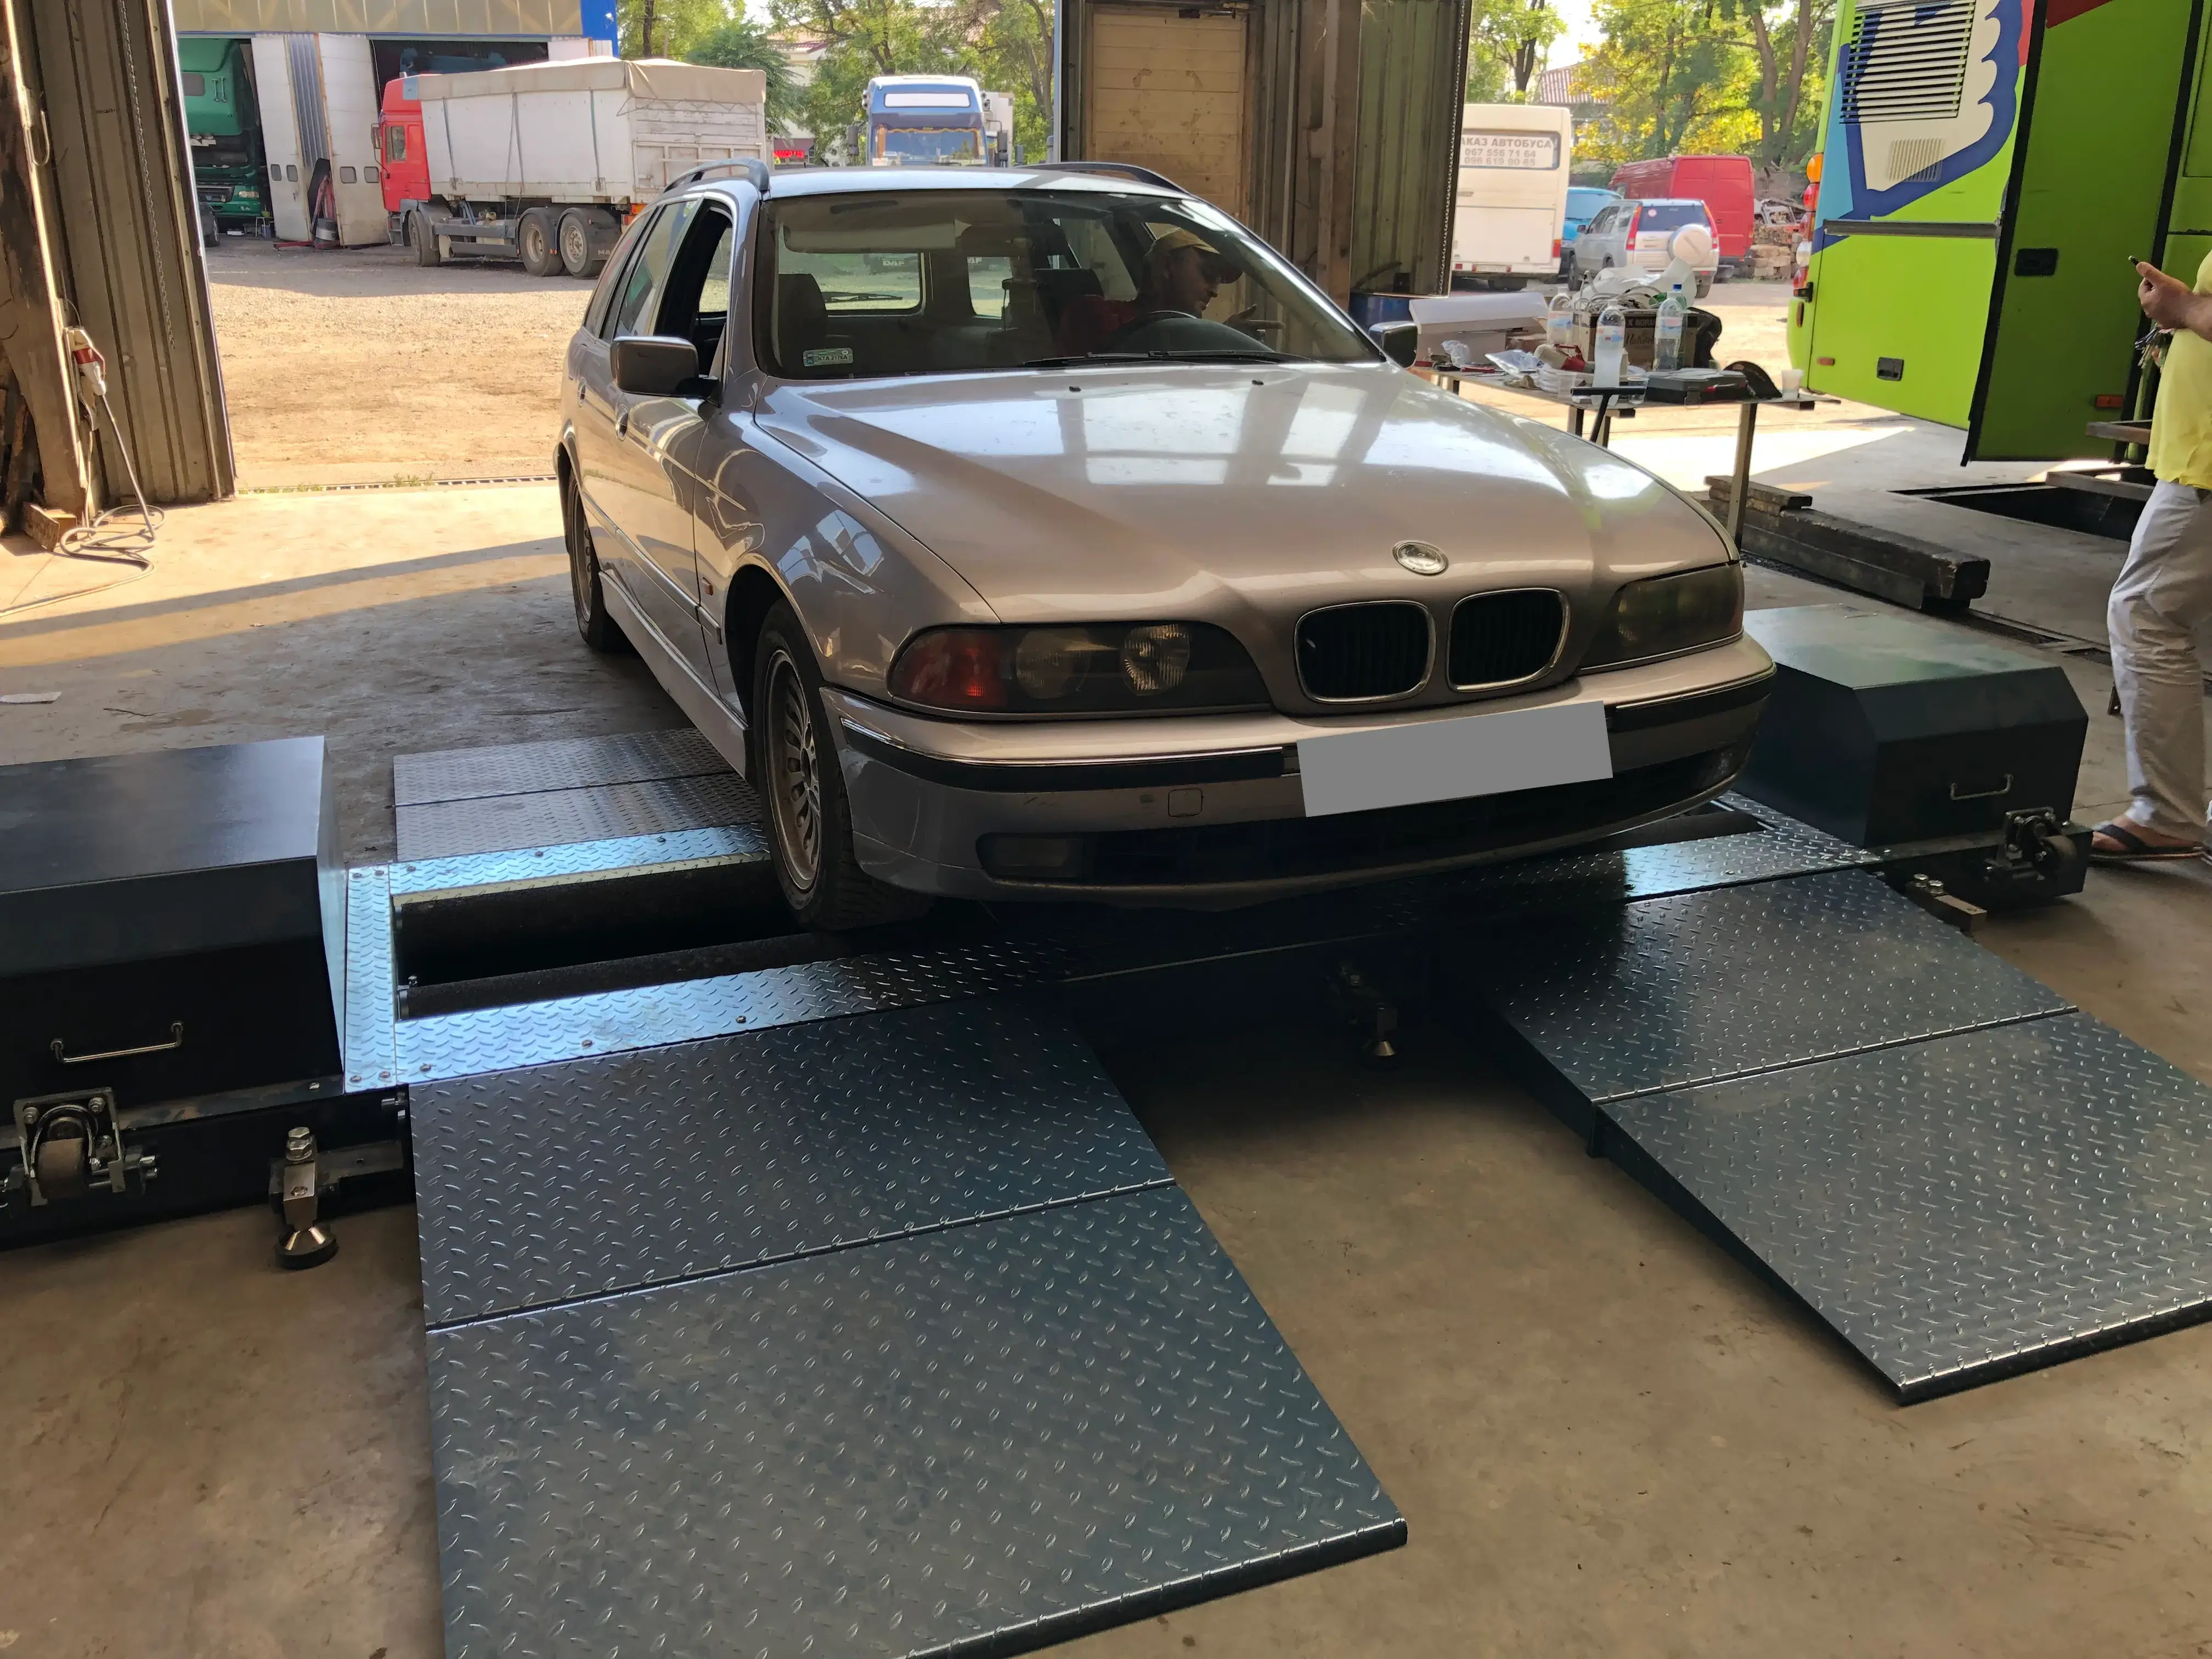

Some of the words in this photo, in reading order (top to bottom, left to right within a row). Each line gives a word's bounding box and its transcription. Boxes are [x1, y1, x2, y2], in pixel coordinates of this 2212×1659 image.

[1491, 138, 1552, 149] АВТОБУСА
[1465, 148, 1483, 156] 067
[1486, 149, 1505, 157] 556
[1509, 150, 1520, 158] 71
[1523, 150, 1536, 159] 64
[1464, 156, 1482, 165] 096
[1486, 157, 1504, 165] 619
[1508, 157, 1520, 166] 90
[1523, 158, 1536, 166] 65
